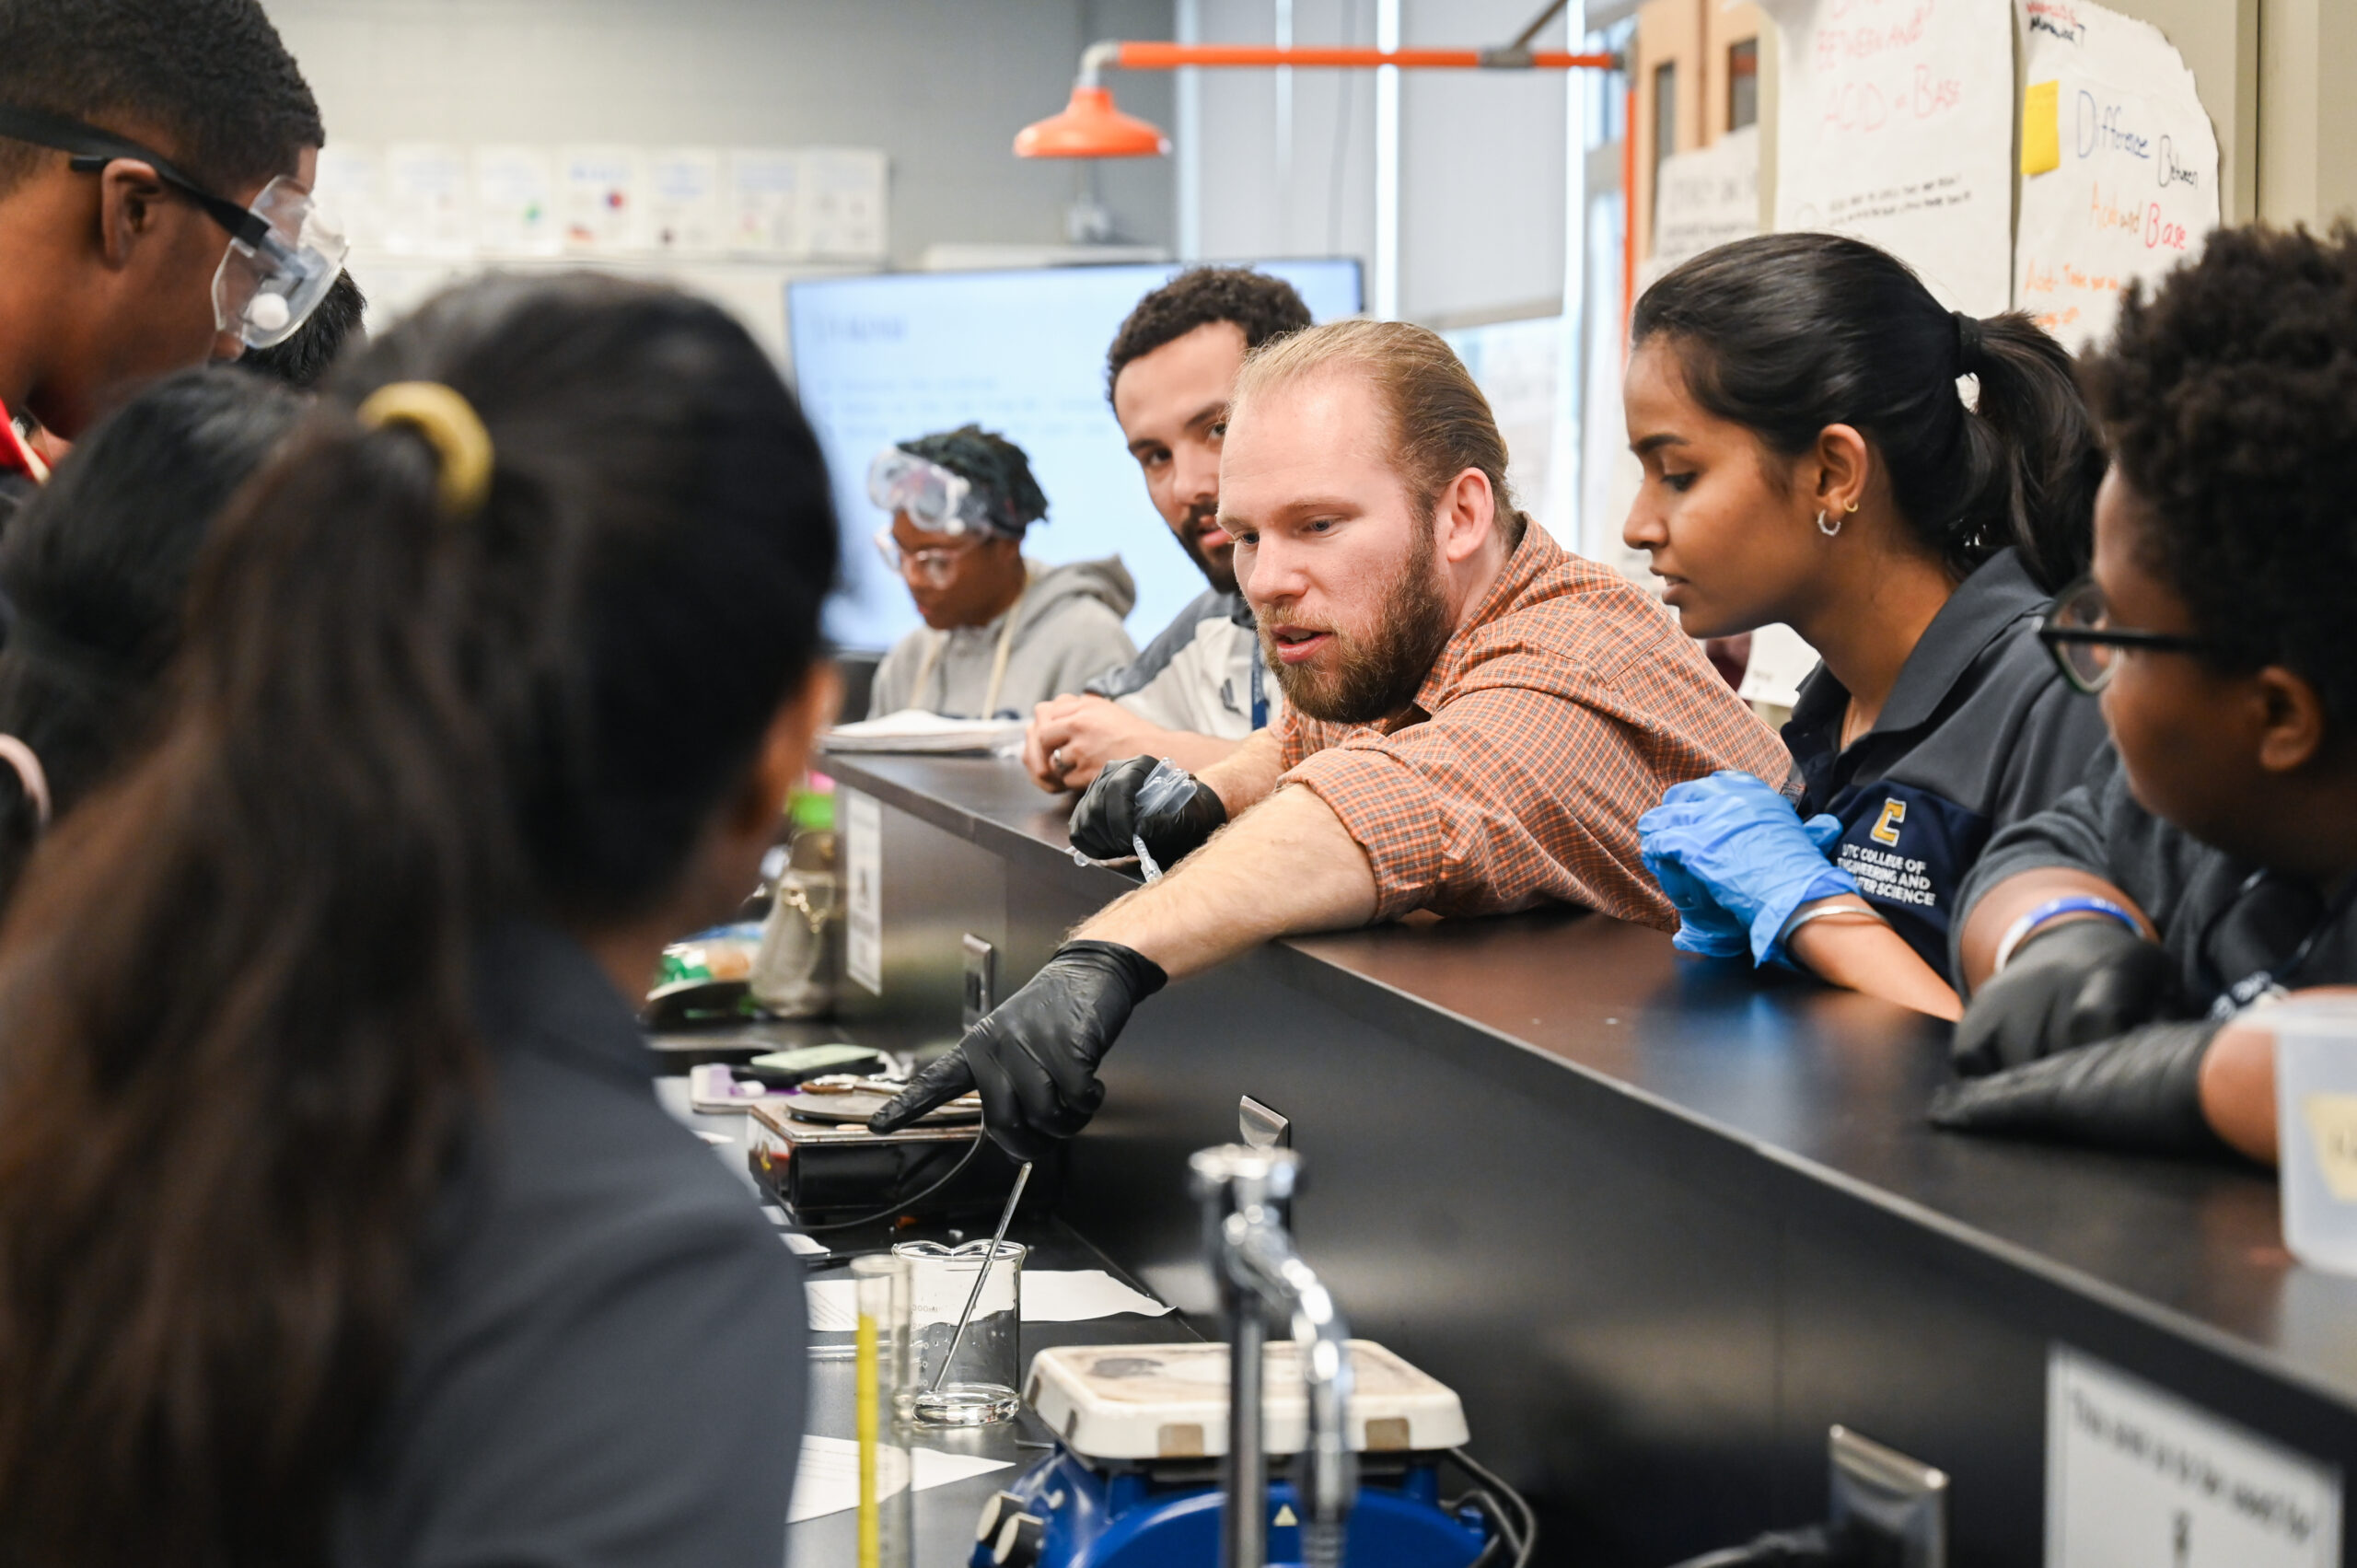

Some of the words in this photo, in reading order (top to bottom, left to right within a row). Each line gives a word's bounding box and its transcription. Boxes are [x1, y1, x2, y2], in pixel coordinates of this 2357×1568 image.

[2145, 202, 2188, 250] Base
[1860, 848, 1904, 870] COLLEGE
[1904, 859, 1927, 875] OF
[1876, 882, 1936, 906] SCIENCE
[1898, 873, 1932, 891] AND
